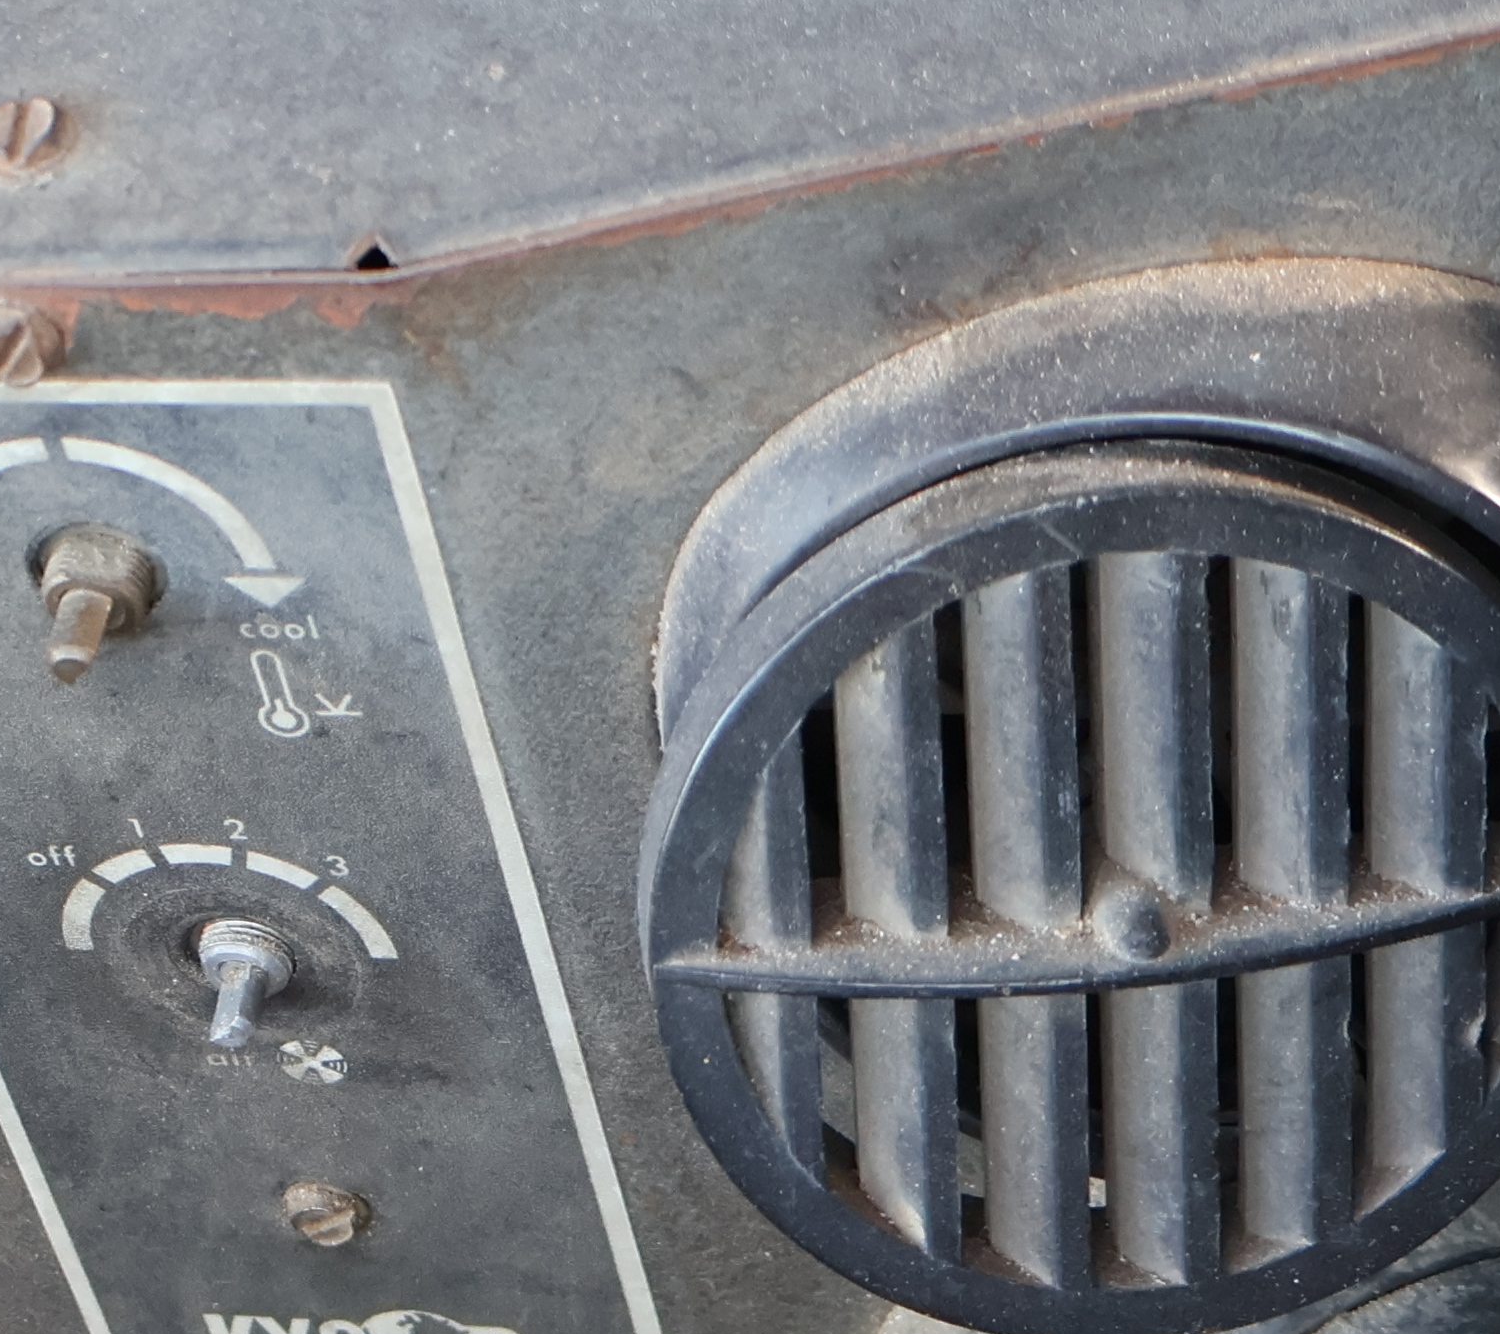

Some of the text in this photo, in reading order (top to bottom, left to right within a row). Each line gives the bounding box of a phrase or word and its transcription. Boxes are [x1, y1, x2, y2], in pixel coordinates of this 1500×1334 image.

[239, 614, 319, 639] cool
[127, 818, 144, 838] 1
[223, 819, 248, 840] 2
[27, 845, 75, 867] off
[326, 855, 349, 877] 3
